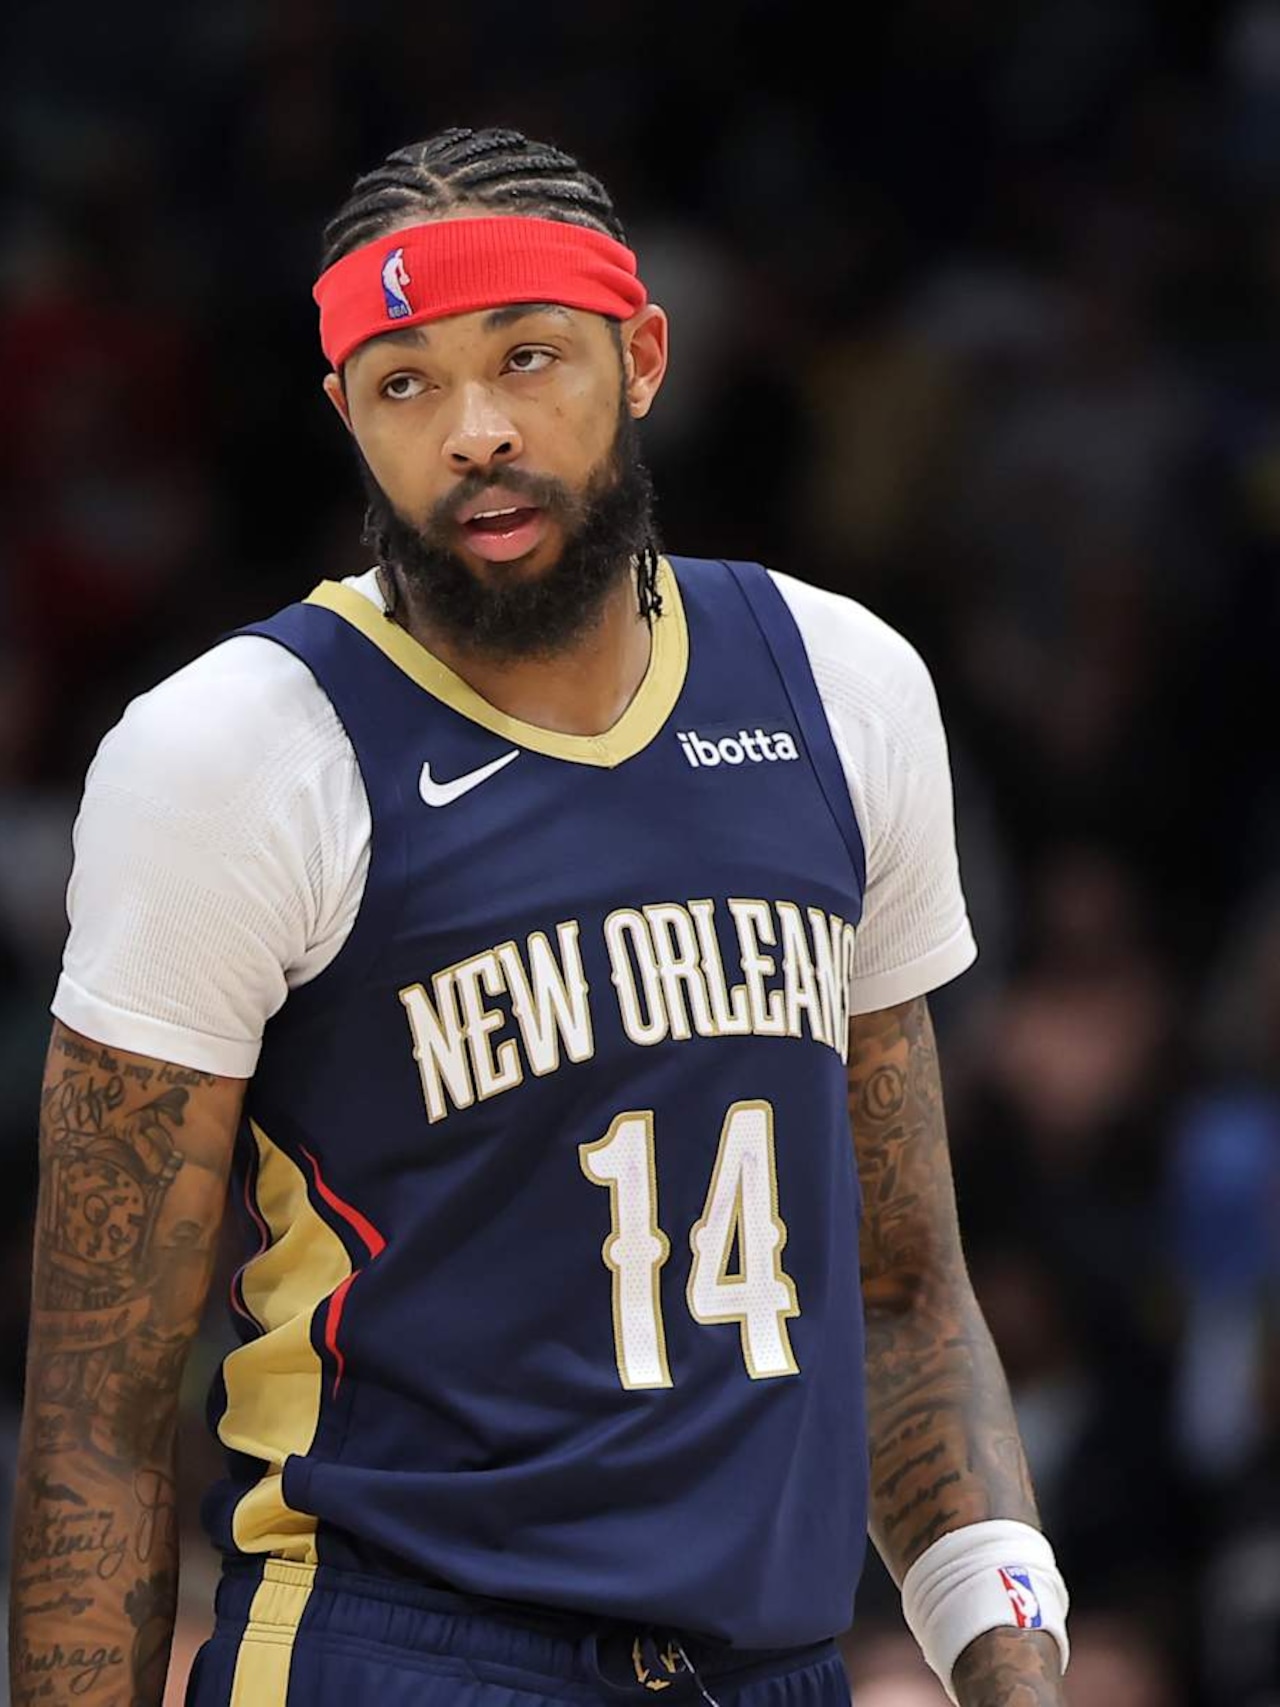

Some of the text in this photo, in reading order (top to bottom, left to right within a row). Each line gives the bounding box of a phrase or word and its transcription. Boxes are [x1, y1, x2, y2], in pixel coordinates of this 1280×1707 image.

[676, 728, 800, 768] ibotta
[398, 919, 595, 1125] NEW
[578, 1098, 802, 1391] 14
